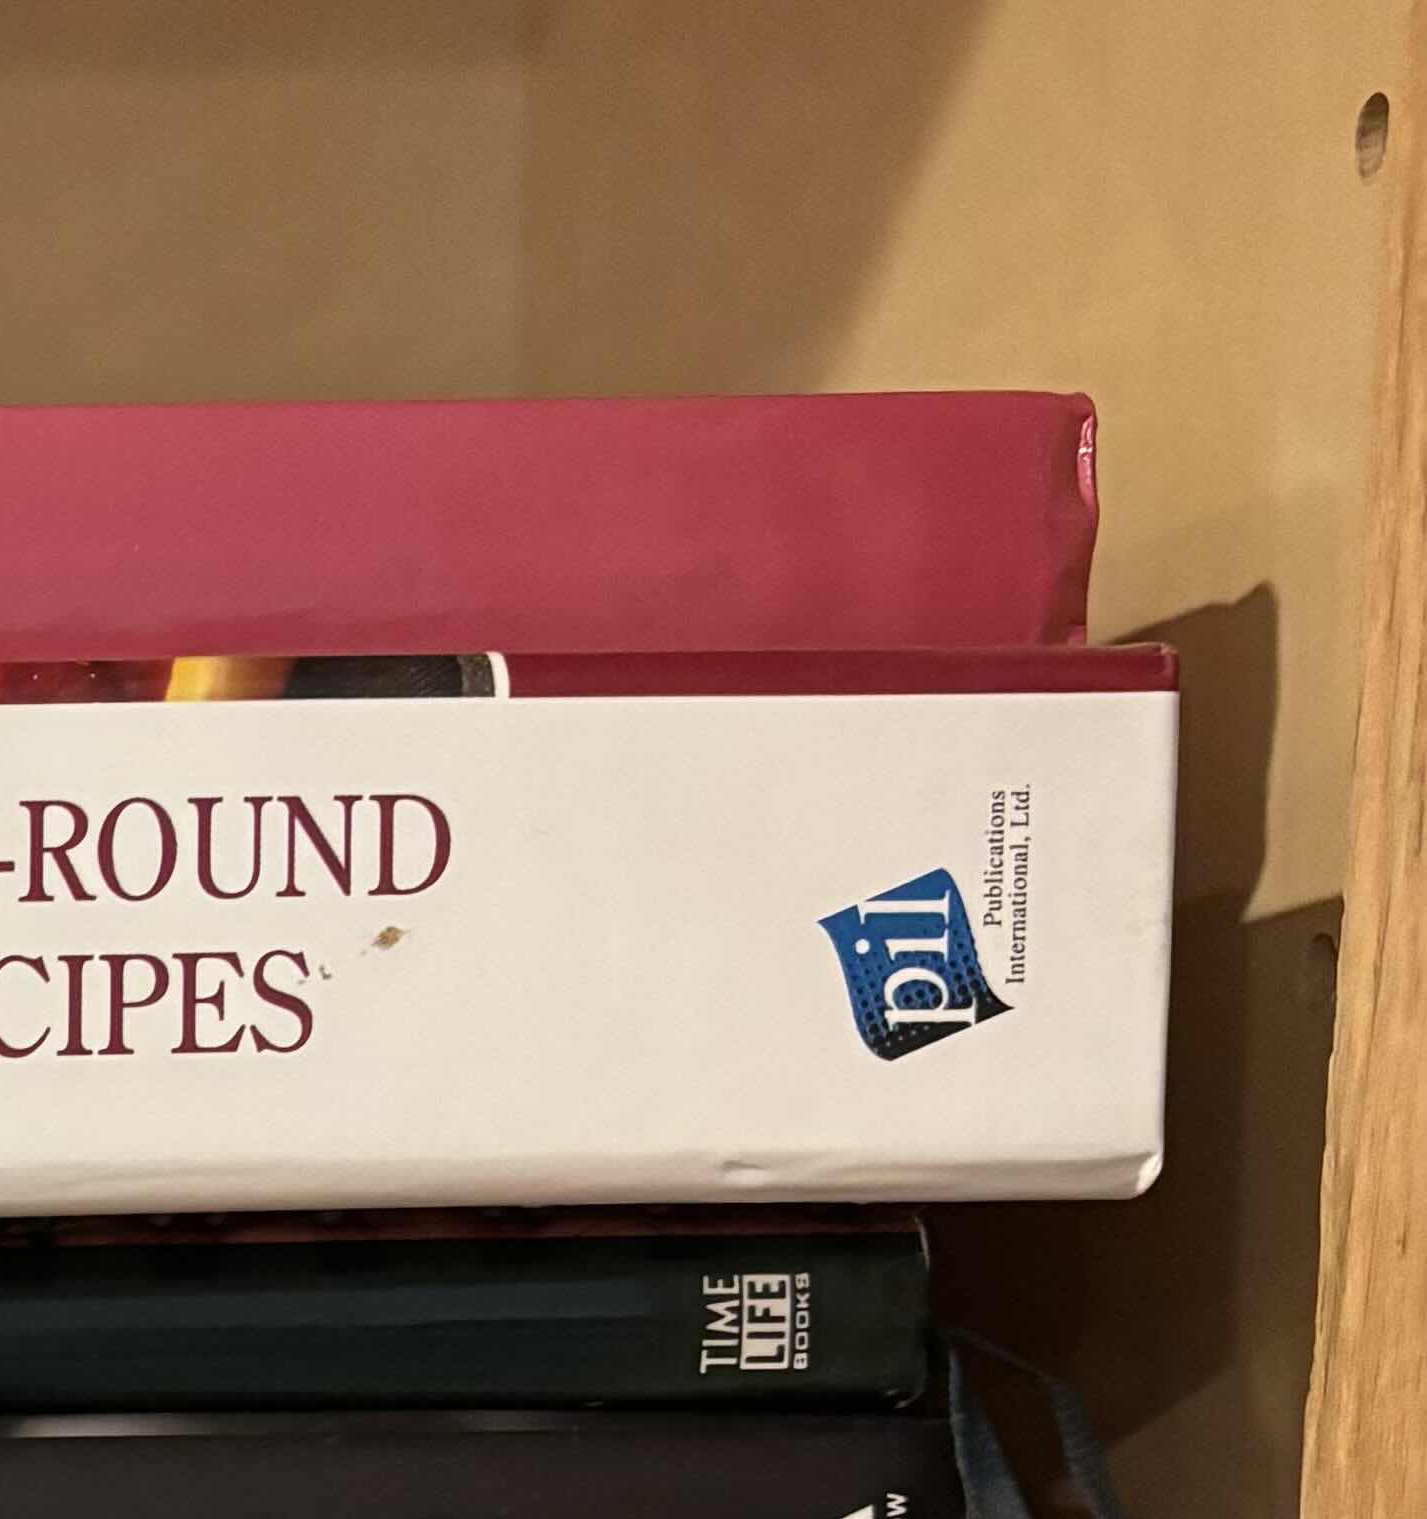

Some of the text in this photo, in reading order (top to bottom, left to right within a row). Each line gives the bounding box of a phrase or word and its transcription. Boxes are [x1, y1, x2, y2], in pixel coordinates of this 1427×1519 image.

[983, 789, 1006, 928] Publications
[1005, 783, 1032, 985] International, Ltd.
[699, 1274, 740, 1374] TIME
[743, 1277, 789, 1367] LIFE
[793, 1272, 810, 1370] BOOKS
